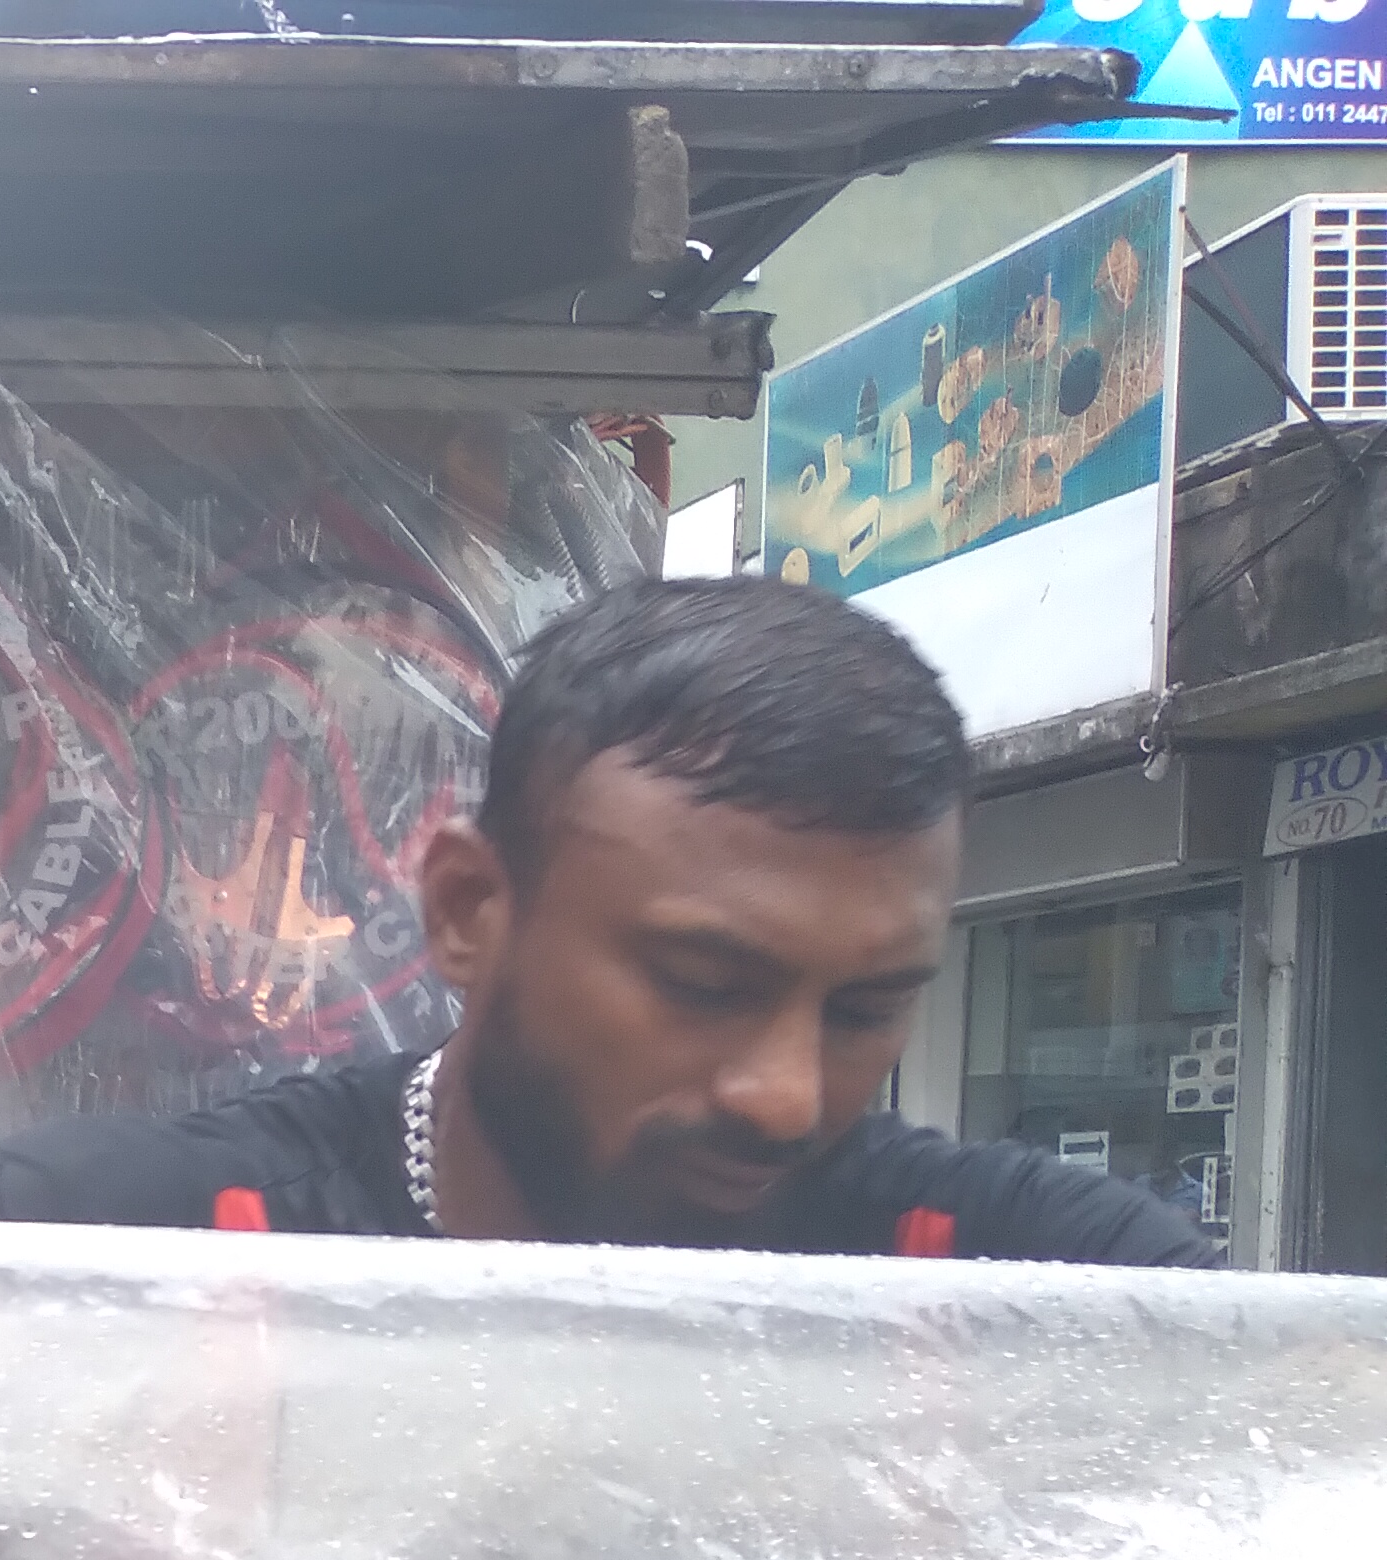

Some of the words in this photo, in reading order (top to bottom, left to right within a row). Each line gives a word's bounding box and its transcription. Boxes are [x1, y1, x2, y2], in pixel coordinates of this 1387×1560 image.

[1252, 58, 1382, 90] ANGEN
[1252, 102, 1284, 122] Tel
[1302, 102, 1336, 122] 011
[1314, 802, 1347, 840] 70
